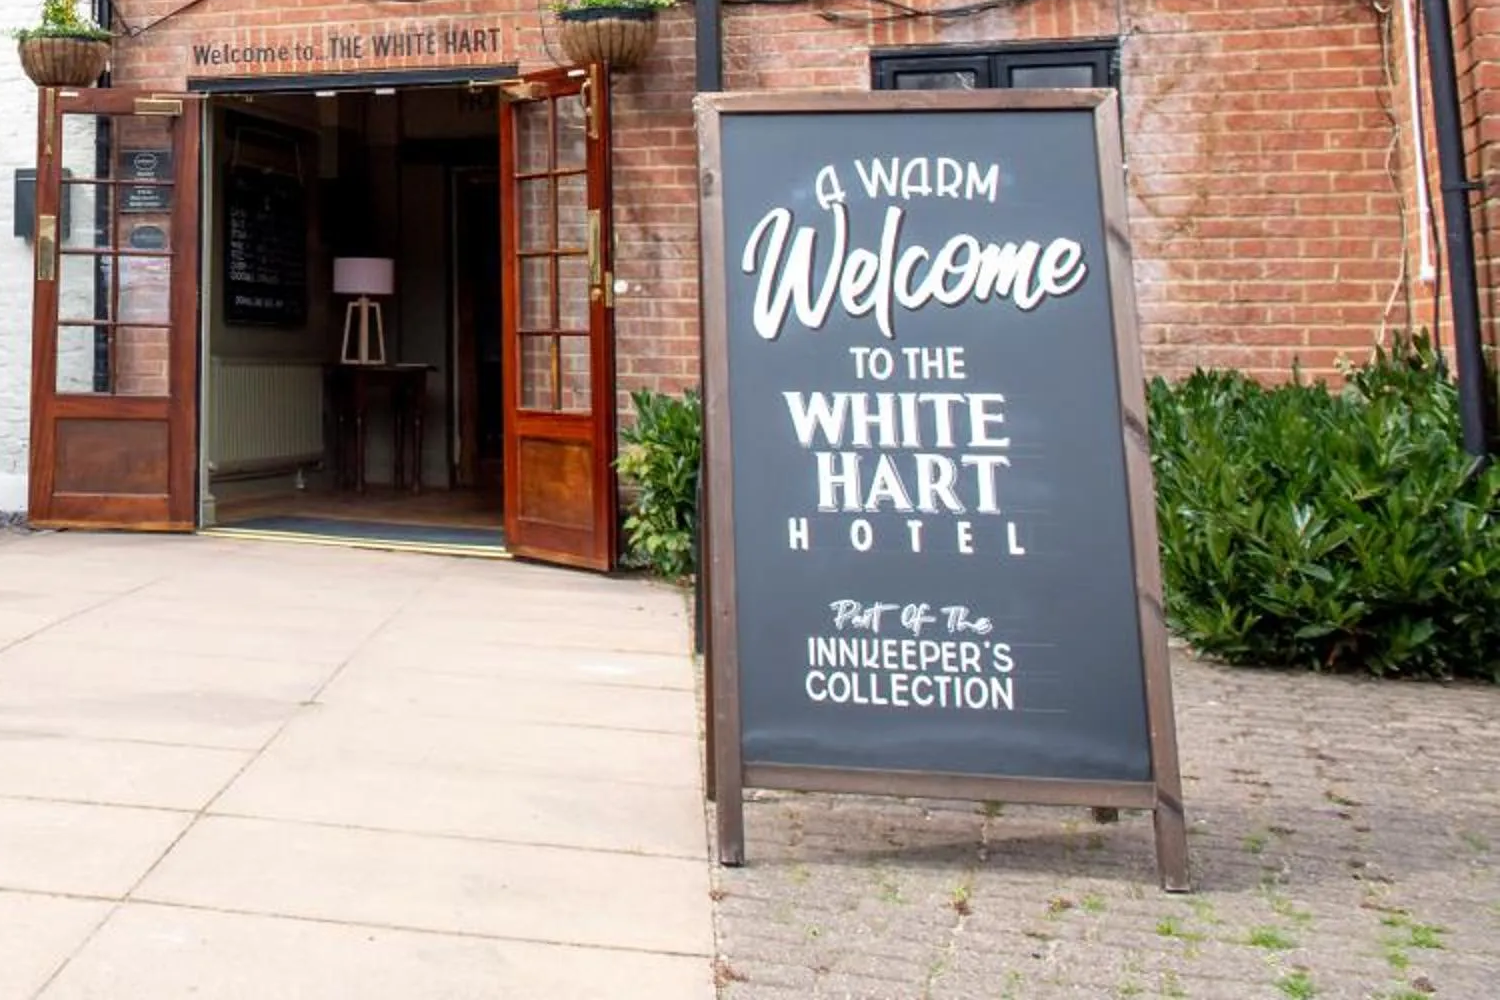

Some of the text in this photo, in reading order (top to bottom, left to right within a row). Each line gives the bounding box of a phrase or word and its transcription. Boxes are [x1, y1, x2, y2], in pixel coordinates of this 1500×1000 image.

[193, 43, 289, 66] Welcome
[329, 36, 363, 60] THE
[372, 31, 437, 57] WHITE
[445, 28, 501, 53] HART
[815, 157, 1000, 209] A WARM
[742, 201, 1087, 340] Welcome
[848, 346, 967, 381] TO THE
[781, 391, 1012, 449] WHITE
[814, 451, 1012, 514] HART
[787, 517, 1027, 555] HOTEL
[829, 599, 994, 637] Part Of The
[807, 637, 1015, 673] INNKEEPER'S
[805, 671, 1015, 710] COLLECTION
